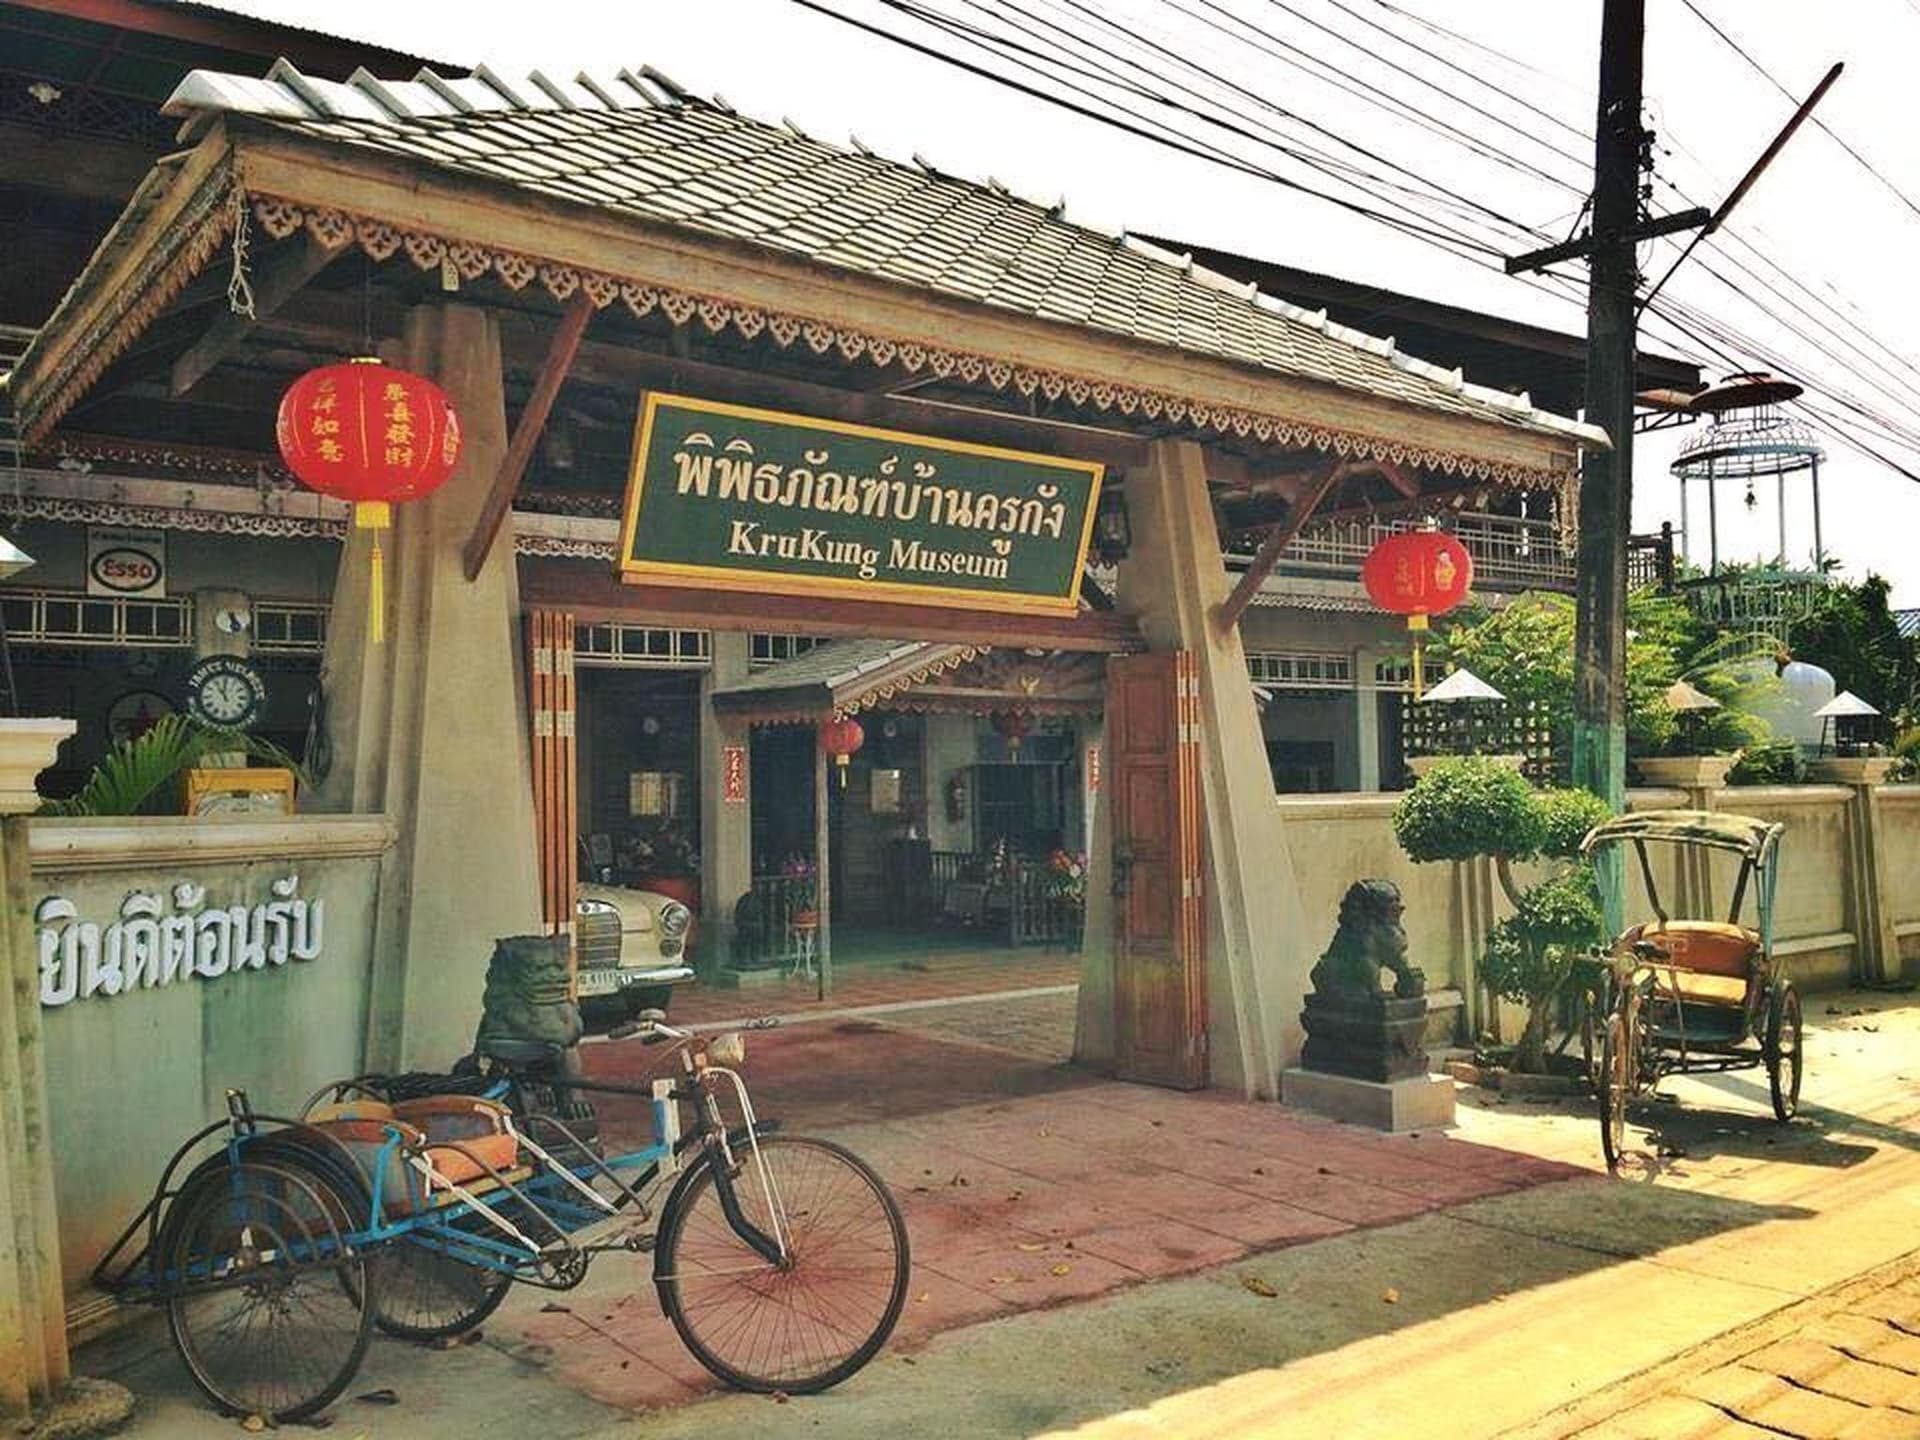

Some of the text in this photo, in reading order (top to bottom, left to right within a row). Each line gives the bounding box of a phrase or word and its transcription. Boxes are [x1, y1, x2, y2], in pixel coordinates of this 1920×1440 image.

[673, 432, 1066, 556] พิพิธภัณฑ์บ้านครูกัง
[727, 519, 1010, 580] KruKung Museum
[38, 874, 324, 1006] ยินดีต้อนรับ
